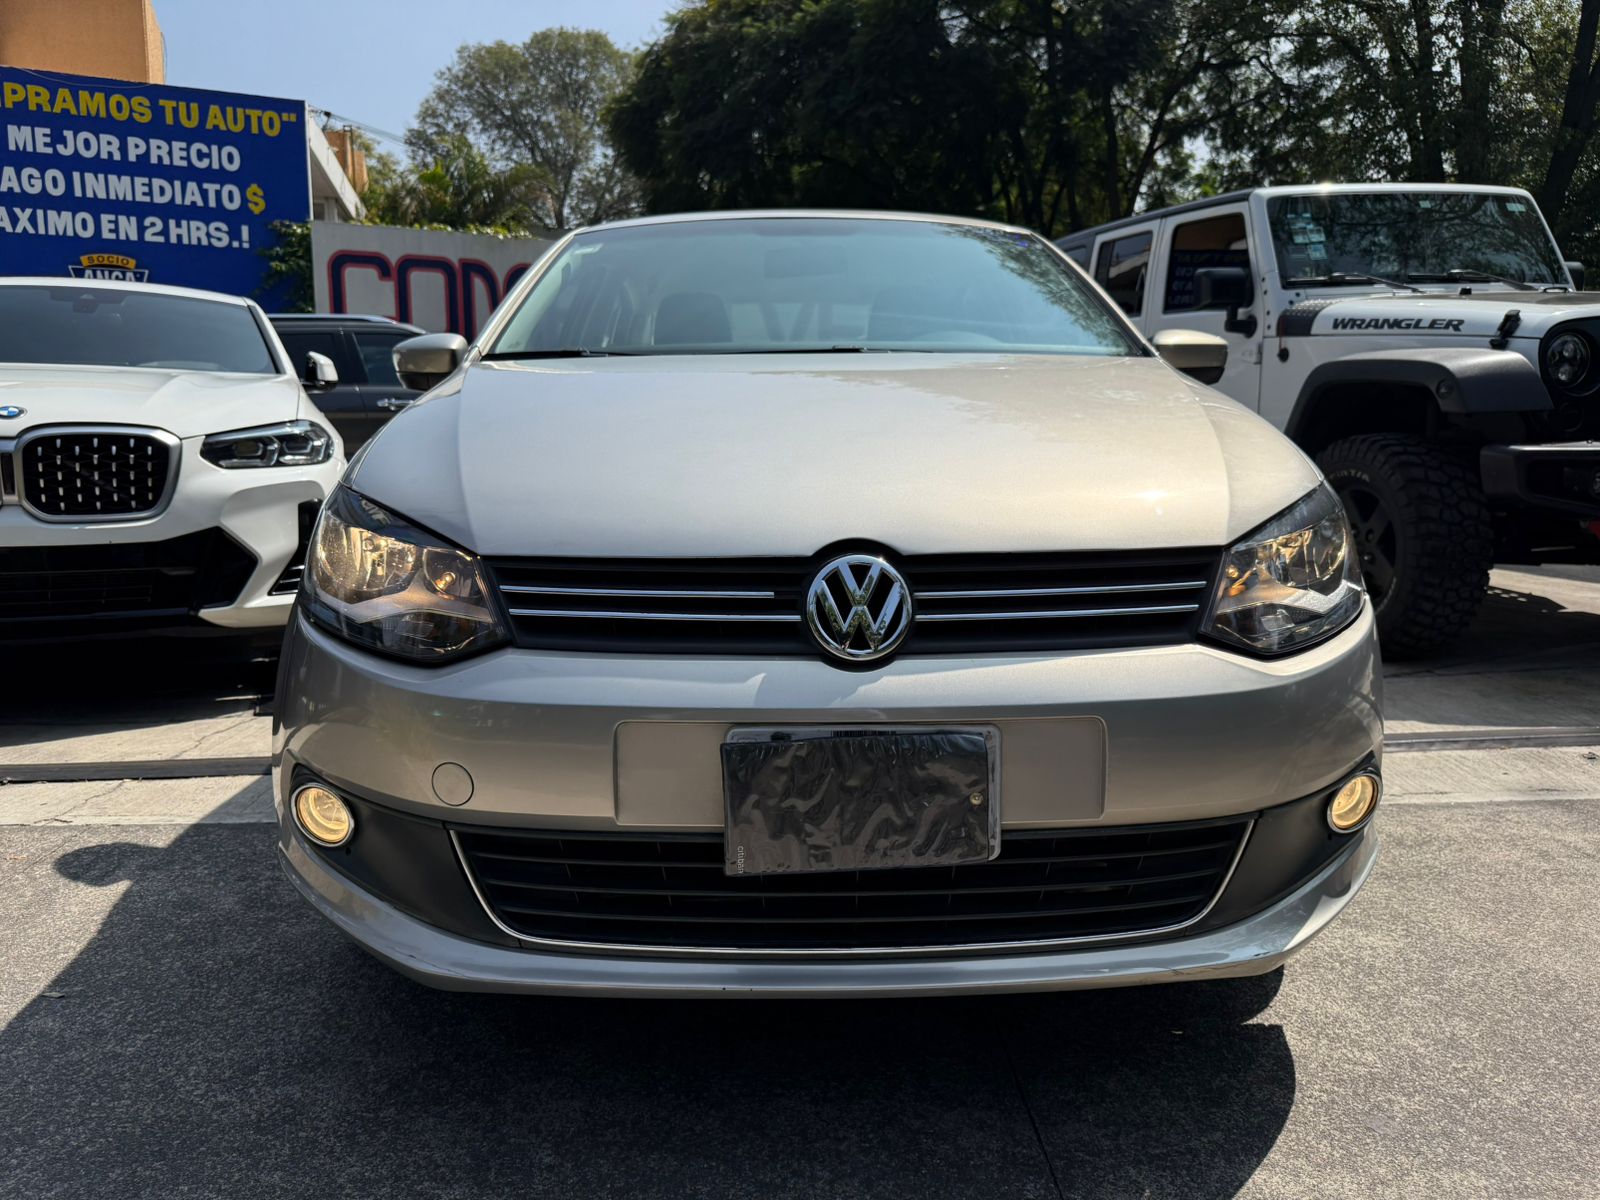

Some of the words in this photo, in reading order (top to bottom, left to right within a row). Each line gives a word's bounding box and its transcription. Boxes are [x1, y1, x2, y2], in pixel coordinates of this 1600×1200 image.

[0, 82, 152, 124] PRAMOS
[159, 99, 200, 128] TU
[7, 124, 121, 161] MEJOR
[127, 136, 241, 172] PRECIO
[0, 166, 66, 197] AGO
[72, 171, 242, 211] INMEDIATO
[246, 183, 266, 215] $
[0, 206, 95, 239] AXIMO
[100, 213, 138, 241] EN
[143, 216, 165, 243] 2
[168, 218, 250, 249] HRS.!
[87, 255, 130, 266] SOCIO
[1332, 318, 1465, 332] WRANGLER
